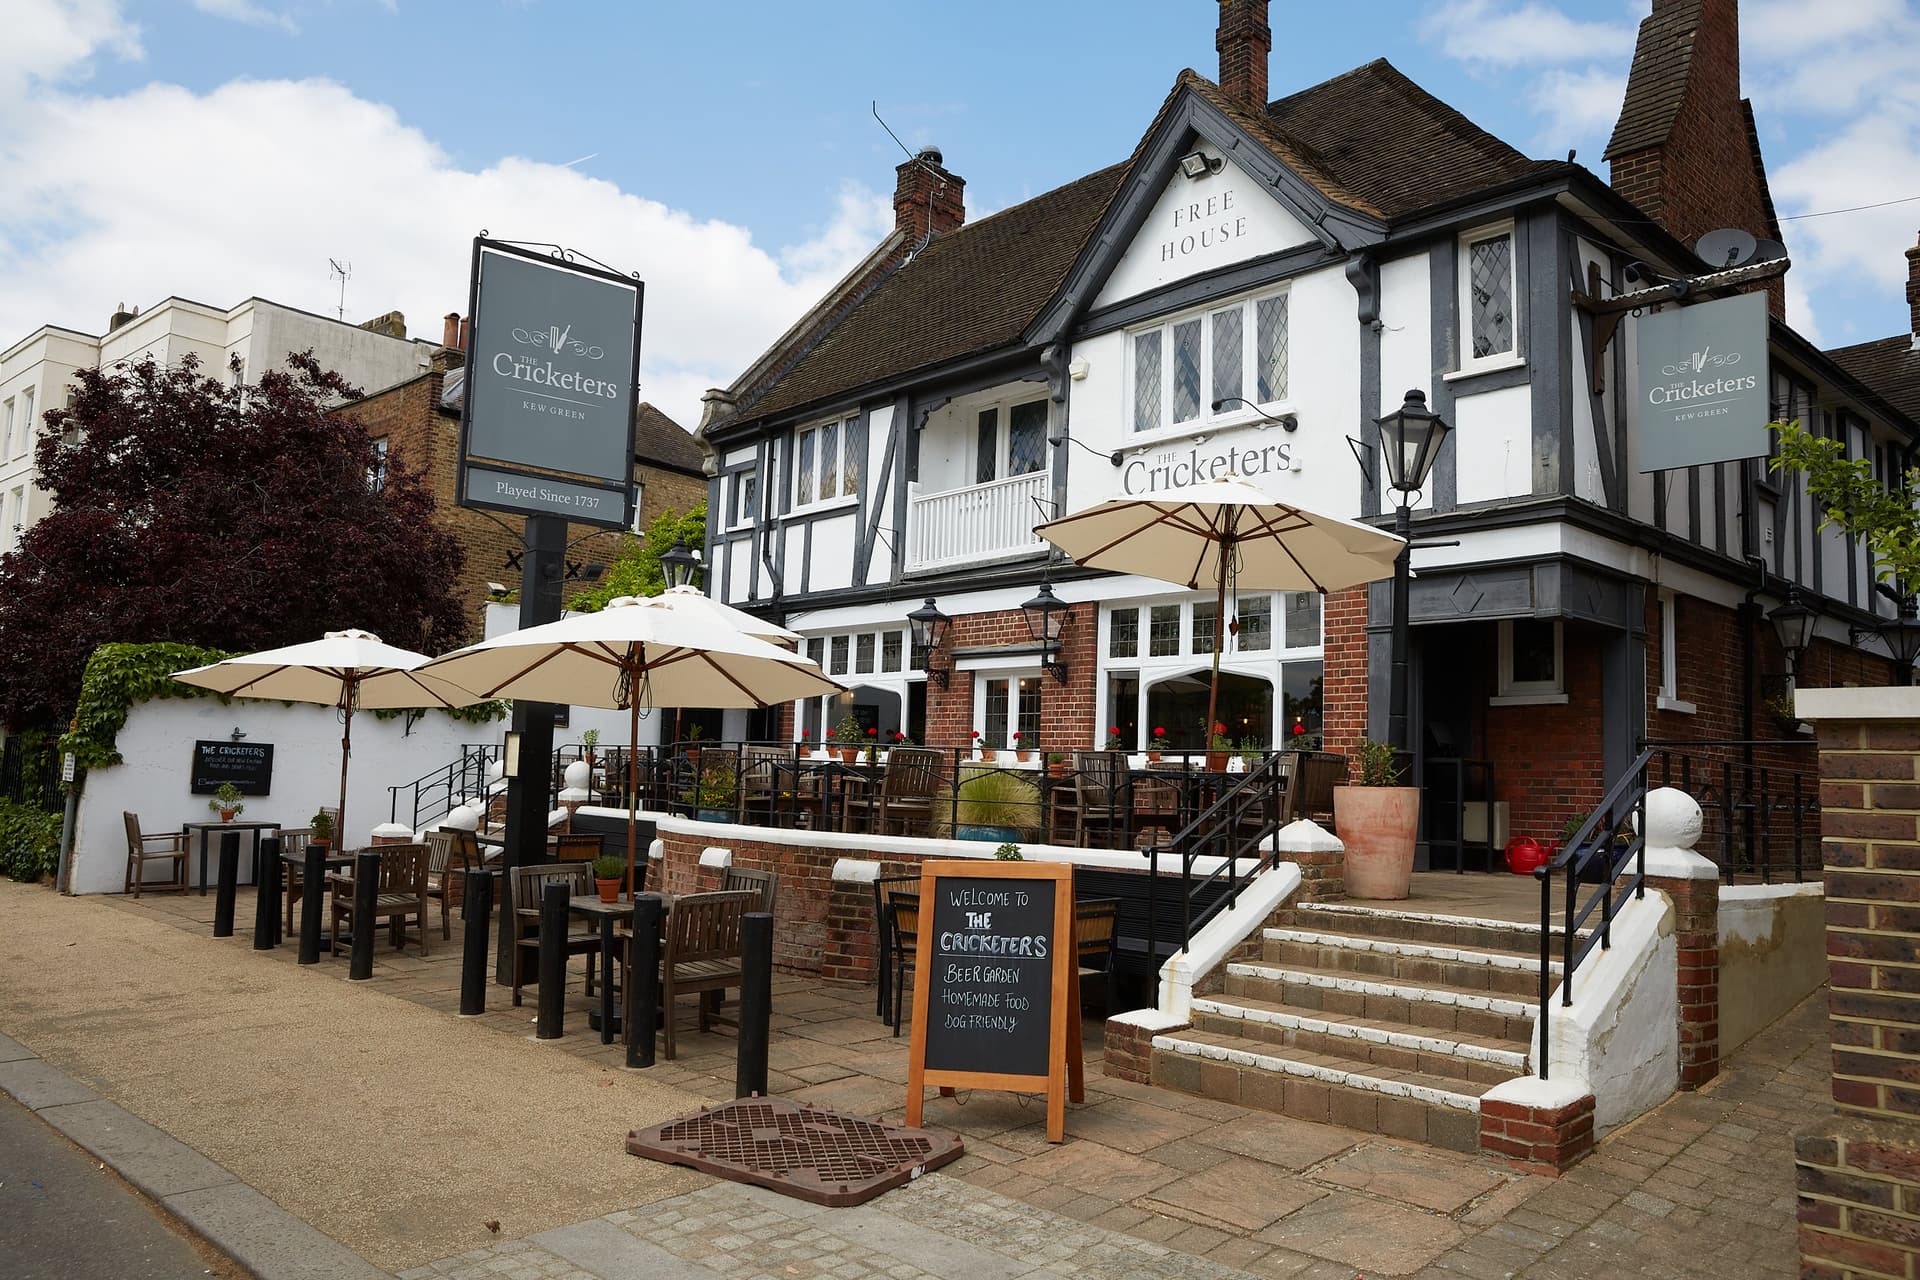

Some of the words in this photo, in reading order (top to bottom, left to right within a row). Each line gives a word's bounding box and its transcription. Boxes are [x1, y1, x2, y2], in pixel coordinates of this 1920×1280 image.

[1173, 190, 1235, 228] FREE
[1160, 217, 1248, 262] HOUSE
[519, 355, 538, 366] THE
[493, 352, 617, 399] Cricketers
[1649, 375, 1756, 405] Cricketers
[1670, 382, 1685, 390] THE
[522, 400, 547, 412] KEW
[550, 406, 586, 420] GREEN
[1675, 413, 1695, 422] KEW
[1697, 407, 1729, 418] GREEN
[1156, 451, 1178, 466] THE
[1123, 444, 1292, 495] Cricketers
[495, 481, 537, 502] Played
[539, 489, 571, 506] Since
[574, 494, 600, 509] 1737
[202, 745, 216, 754] THE
[219, 746, 265, 757] CRICKETERS
[950, 888, 1010, 907] WELCOME
[1015, 891, 1029, 906] TO
[965, 911, 992, 929] THE
[940, 931, 1047, 957] CRICKETERS
[943, 963, 981, 984] BEER
[983, 966, 1020, 984] GARDEN
[941, 988, 1000, 1008] HOMEMADE
[1004, 993, 1030, 1011] FOOD
[944, 1013, 967, 1029] DOG
[969, 1014, 1017, 1033] FRIENDLY
